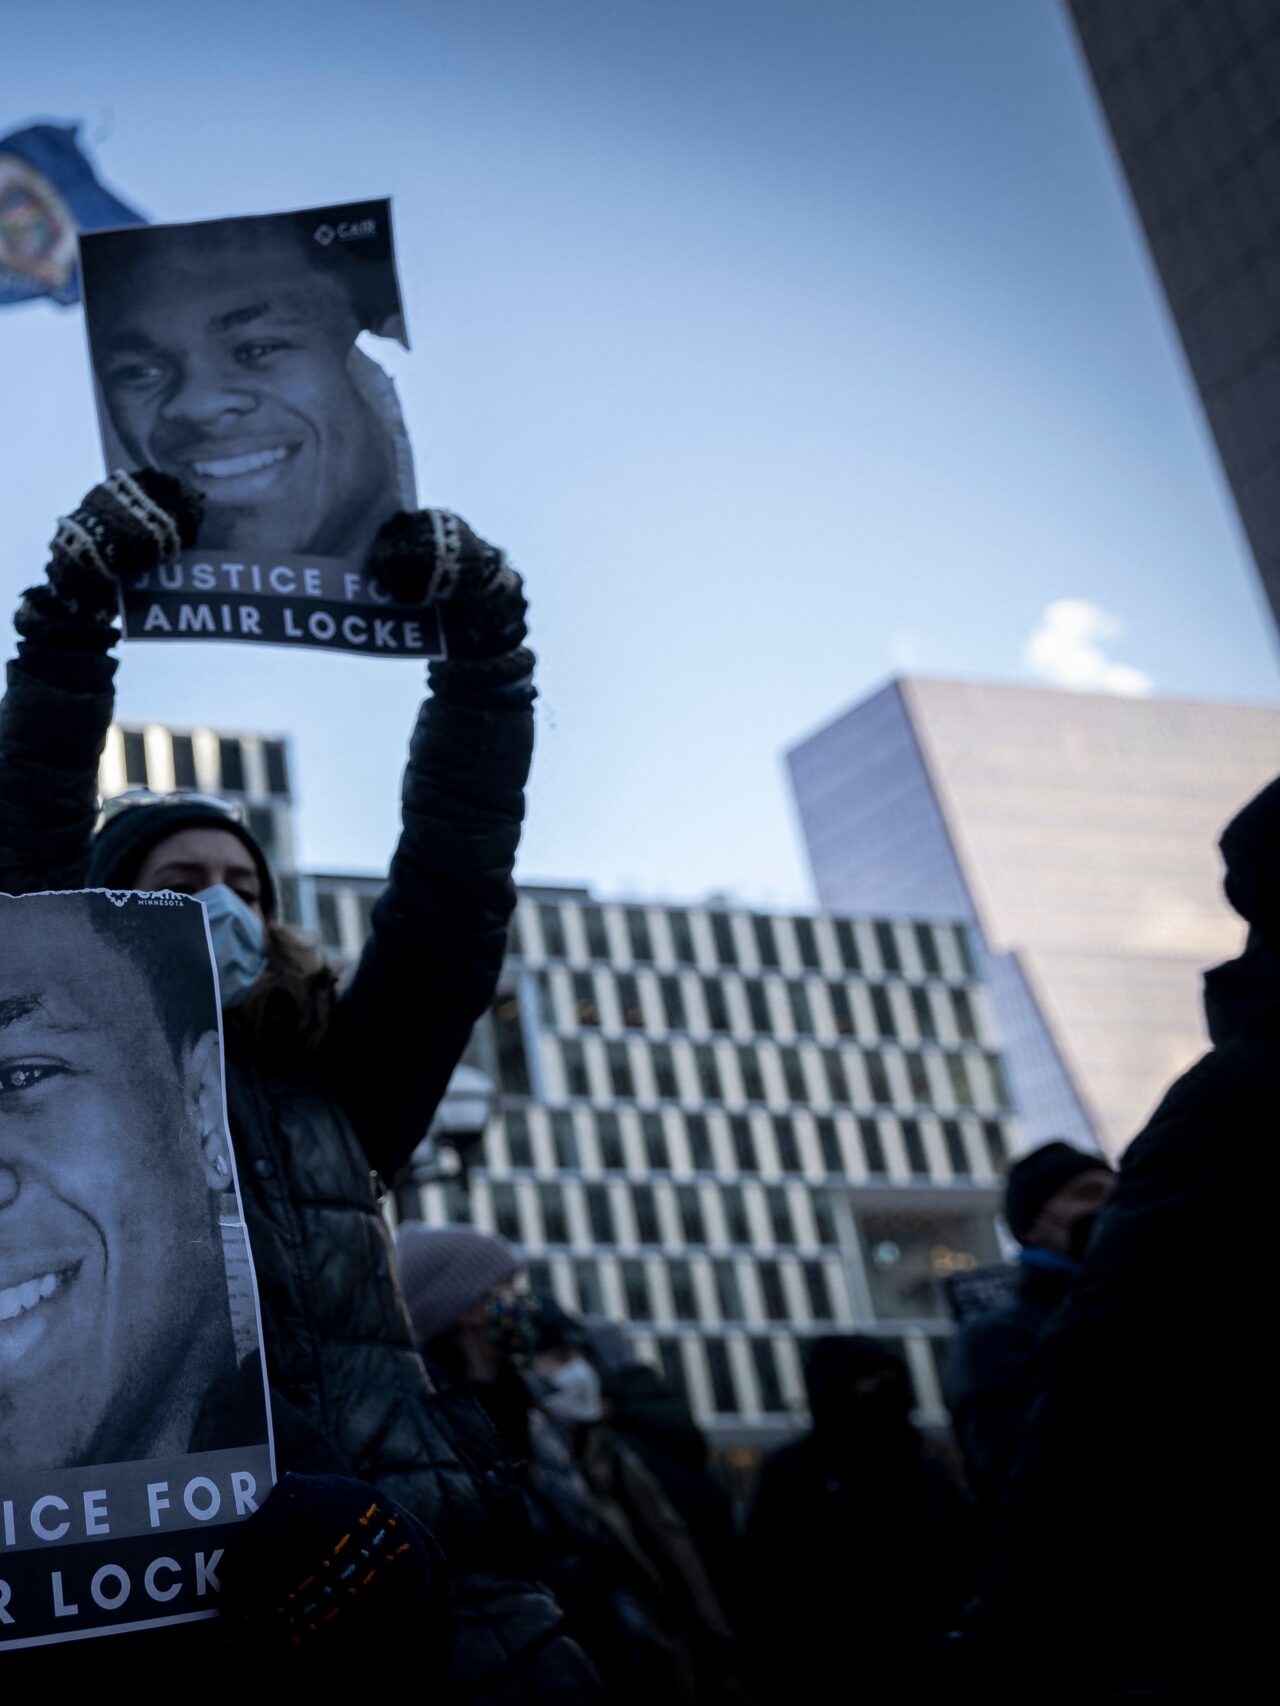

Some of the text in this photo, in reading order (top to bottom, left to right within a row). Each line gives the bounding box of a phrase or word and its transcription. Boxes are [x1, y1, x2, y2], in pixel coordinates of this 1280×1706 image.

[134, 563, 394, 605] JUSTICE FO
[143, 603, 424, 649] AMIR LOCKE
[137, 899, 184, 907] MINNESOTA
[146, 1470, 259, 1528] FOR
[50, 1548, 225, 1619] LOCK
